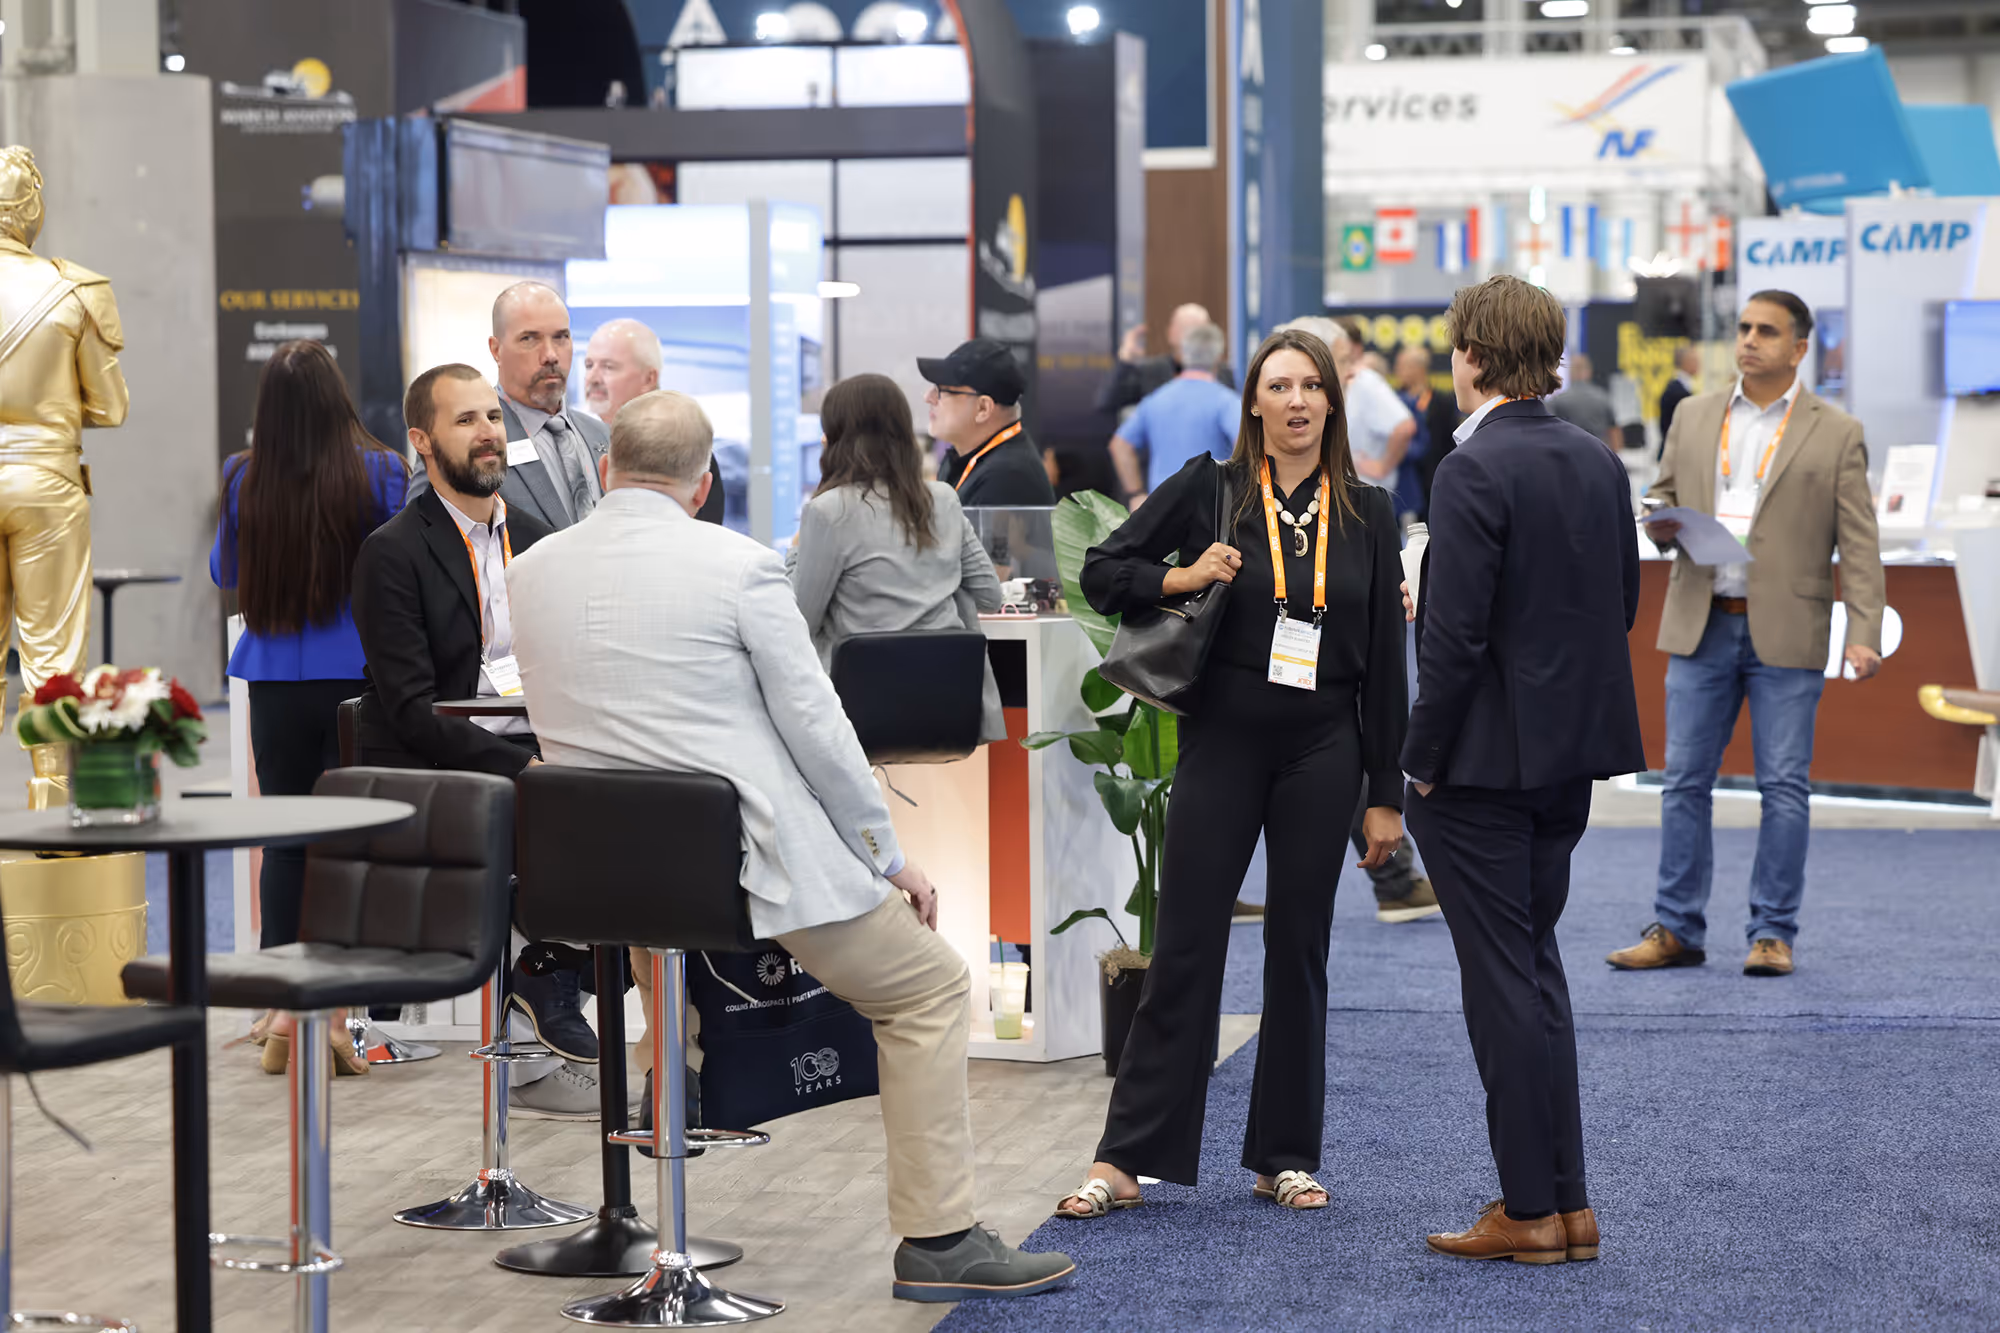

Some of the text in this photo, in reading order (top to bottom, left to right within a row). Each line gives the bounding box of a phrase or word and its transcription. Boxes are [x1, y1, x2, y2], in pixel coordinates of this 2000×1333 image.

[1860, 222, 1971, 253] CAMP
[220, 290, 266, 311] OUR
[725, 1002, 749, 1013] COLLINS
[795, 1075, 842, 1096] YEARS
